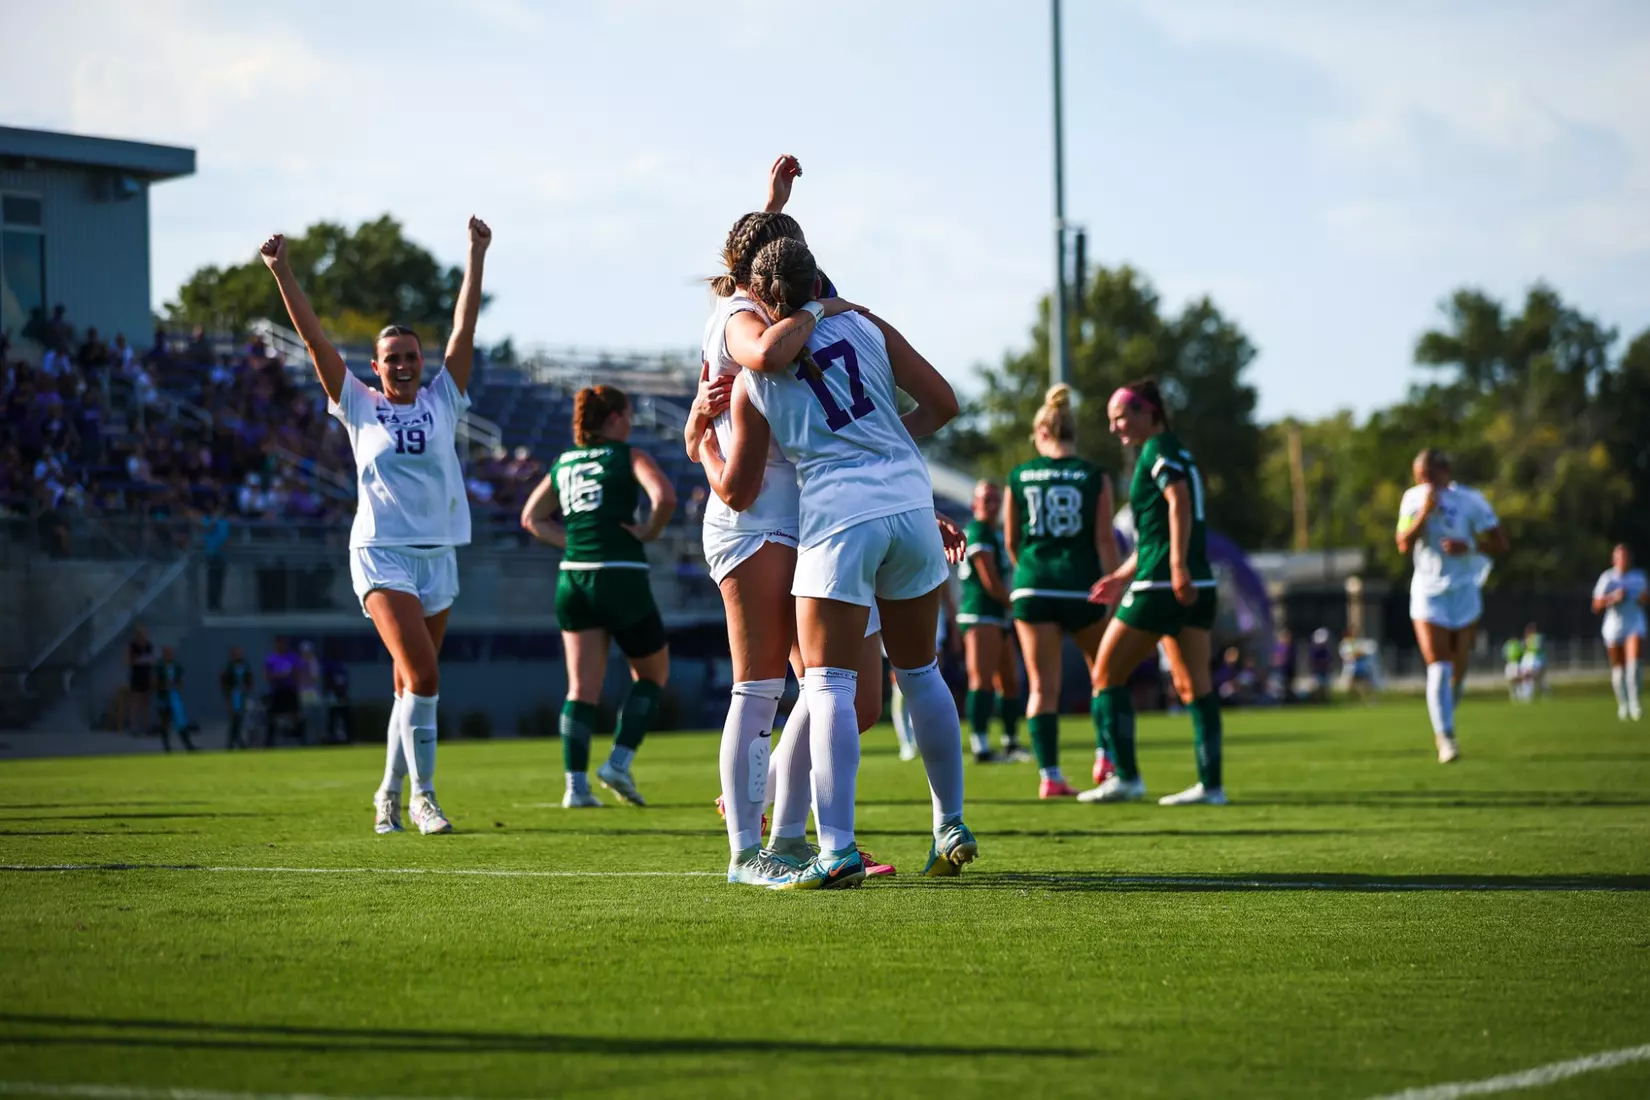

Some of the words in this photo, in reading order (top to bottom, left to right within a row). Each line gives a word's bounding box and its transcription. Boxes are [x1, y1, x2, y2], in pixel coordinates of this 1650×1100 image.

[795, 338, 876, 433] 17
[395, 428, 426, 455] 19
[1023, 485, 1083, 537] 18
